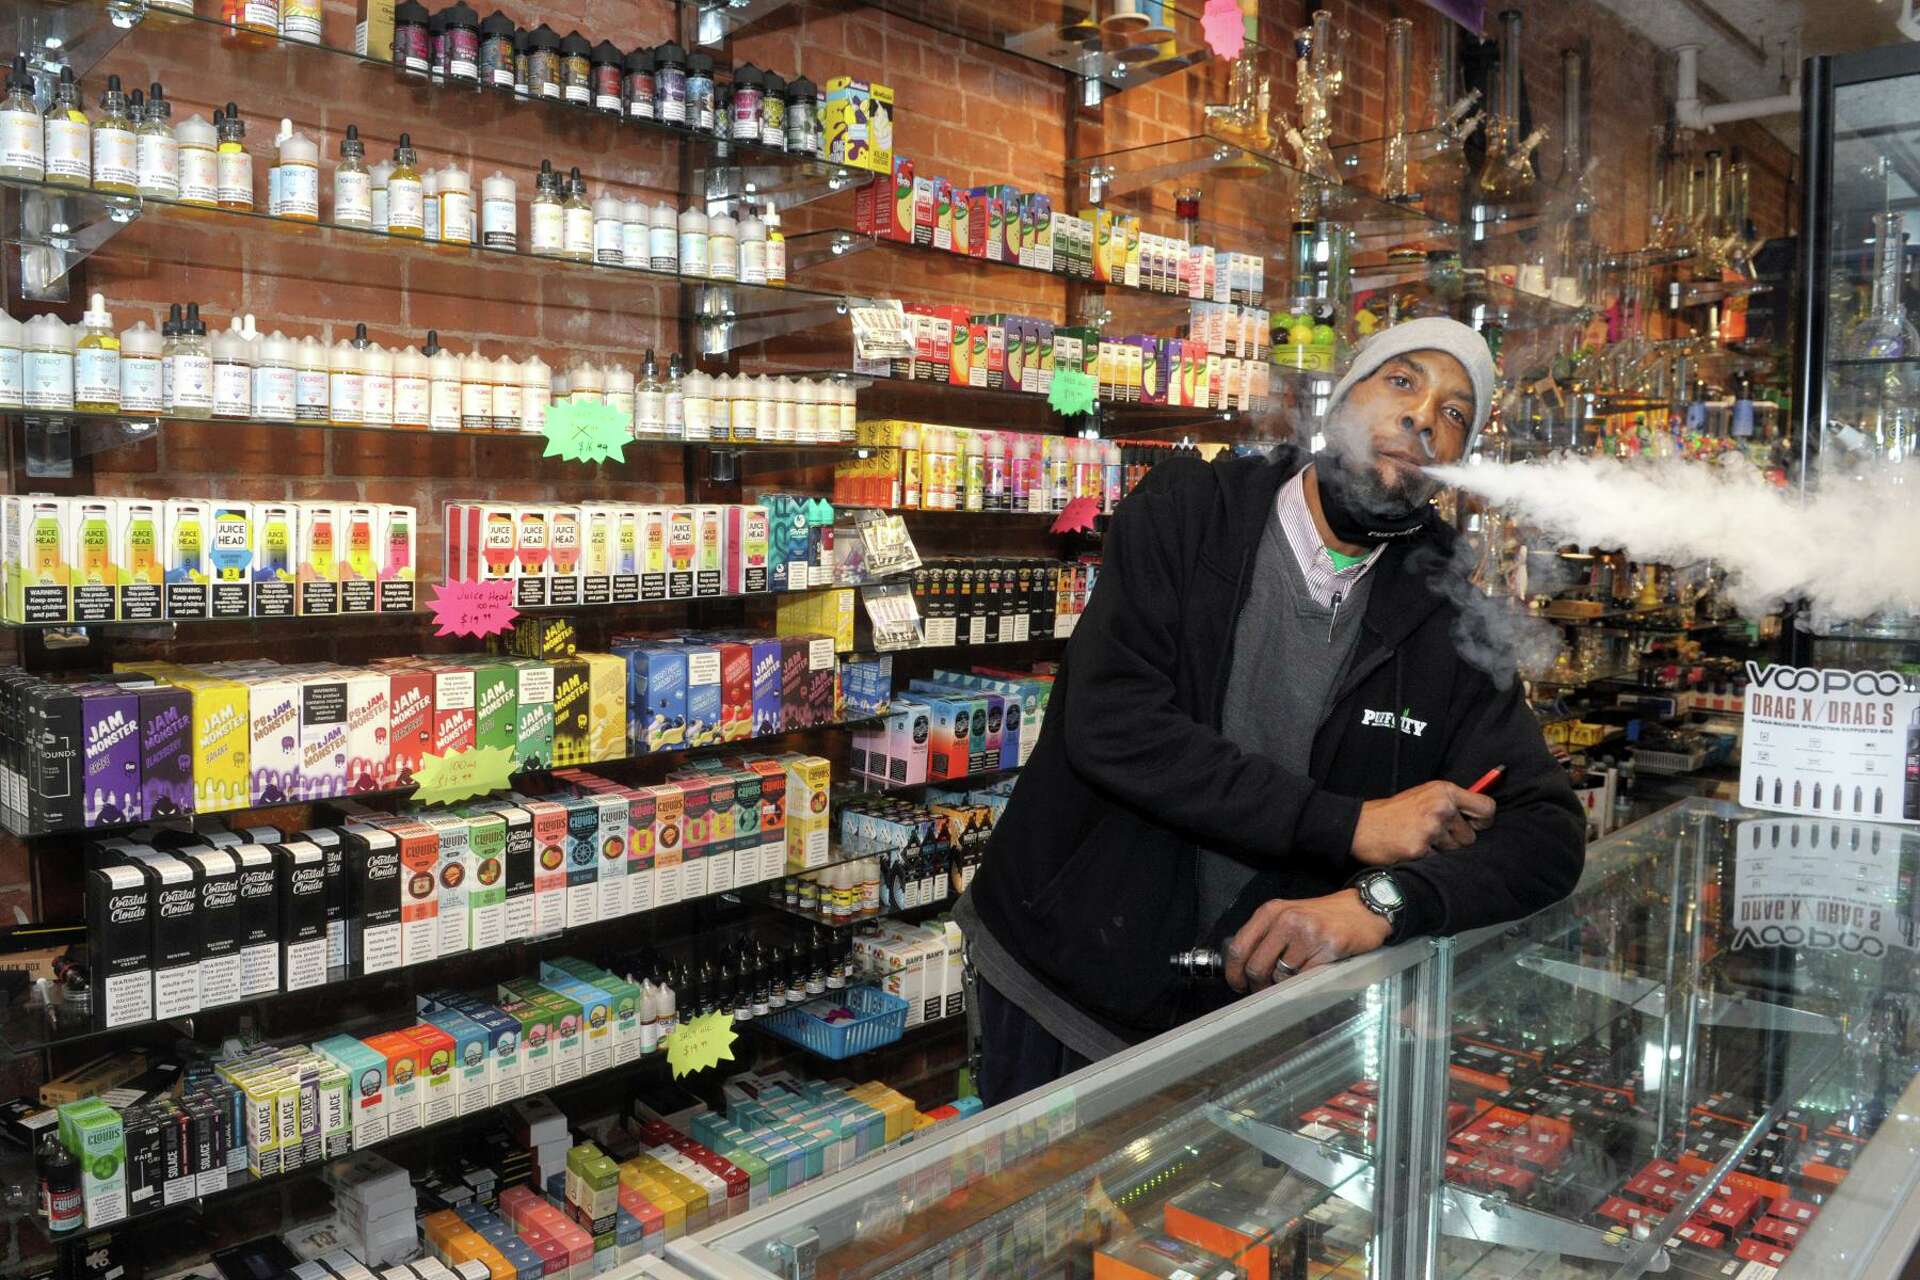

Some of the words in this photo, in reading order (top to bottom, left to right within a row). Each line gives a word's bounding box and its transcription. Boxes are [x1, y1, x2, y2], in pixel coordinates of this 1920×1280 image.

[218, 525, 245, 534] JUICE
[218, 536, 245, 545] HEAD
[490, 526, 510, 534] JUICE
[543, 625, 574, 652] MONSTER
[544, 618, 566, 641] JAM
[753, 659, 780, 688] MONSTER
[755, 653, 774, 677] JAM
[556, 673, 580, 700] JAM
[1749, 662, 1901, 697] VOOPOO
[367, 692, 384, 710] JAM
[392, 686, 420, 715] JAM
[479, 688, 515, 720] MONSTER
[480, 680, 506, 707] JAM
[554, 681, 589, 713] MONSTER
[146, 706, 178, 736] JAM
[203, 703, 235, 734] JAM
[254, 716, 266, 730] PB
[272, 699, 292, 718] JAM
[349, 699, 389, 731] MONSTER
[391, 694, 432, 728] MONSTER
[520, 705, 545, 730] JAM
[1752, 692, 1796, 720] DRAG
[1802, 698, 1812, 722] X
[1828, 700, 1876, 725] DRAG
[1883, 702, 1894, 726] S
[89, 710, 124, 744] JAM
[145, 714, 191, 750] MONSTER
[201, 712, 248, 749] MONSTER
[253, 707, 297, 742] MONSTER
[323, 726, 342, 746] JAM
[436, 718, 473, 749] MONSTER
[438, 710, 464, 737] JAM
[519, 711, 553, 743] MONSTER
[86, 719, 139, 759] MONSTER
[303, 734, 348, 768] MONSTER
[600, 809, 628, 823] CLOUDS
[657, 799, 683, 813] CLOUDS
[538, 819, 566, 833] CLOUDS
[406, 842, 438, 859] CLOUDS
[438, 833, 468, 848] CLOUDS
[367, 853, 399, 868] Coastal
[368, 865, 398, 880] Clouds
[202, 880, 239, 897] Coastal
[240, 869, 275, 887] Coastal
[292, 866, 325, 884] Coastal
[293, 881, 324, 896] Clouds
[109, 893, 148, 911] Coastal
[160, 888, 197, 905] Coastal
[203, 892, 237, 909] Clouds
[240, 883, 273, 898] Clouds
[111, 907, 147, 923] Clouds
[160, 901, 195, 918] Clouds
[258, 1104, 271, 1144] SOLACE
[282, 1100, 294, 1138] SOLACE
[301, 1092, 313, 1130] SOLACE
[329, 1092, 341, 1129] SOLACE
[87, 1127, 121, 1146] CLOUDS
[168, 1150, 178, 1178] SOLACE
[200, 1143, 210, 1170] SOLACE
